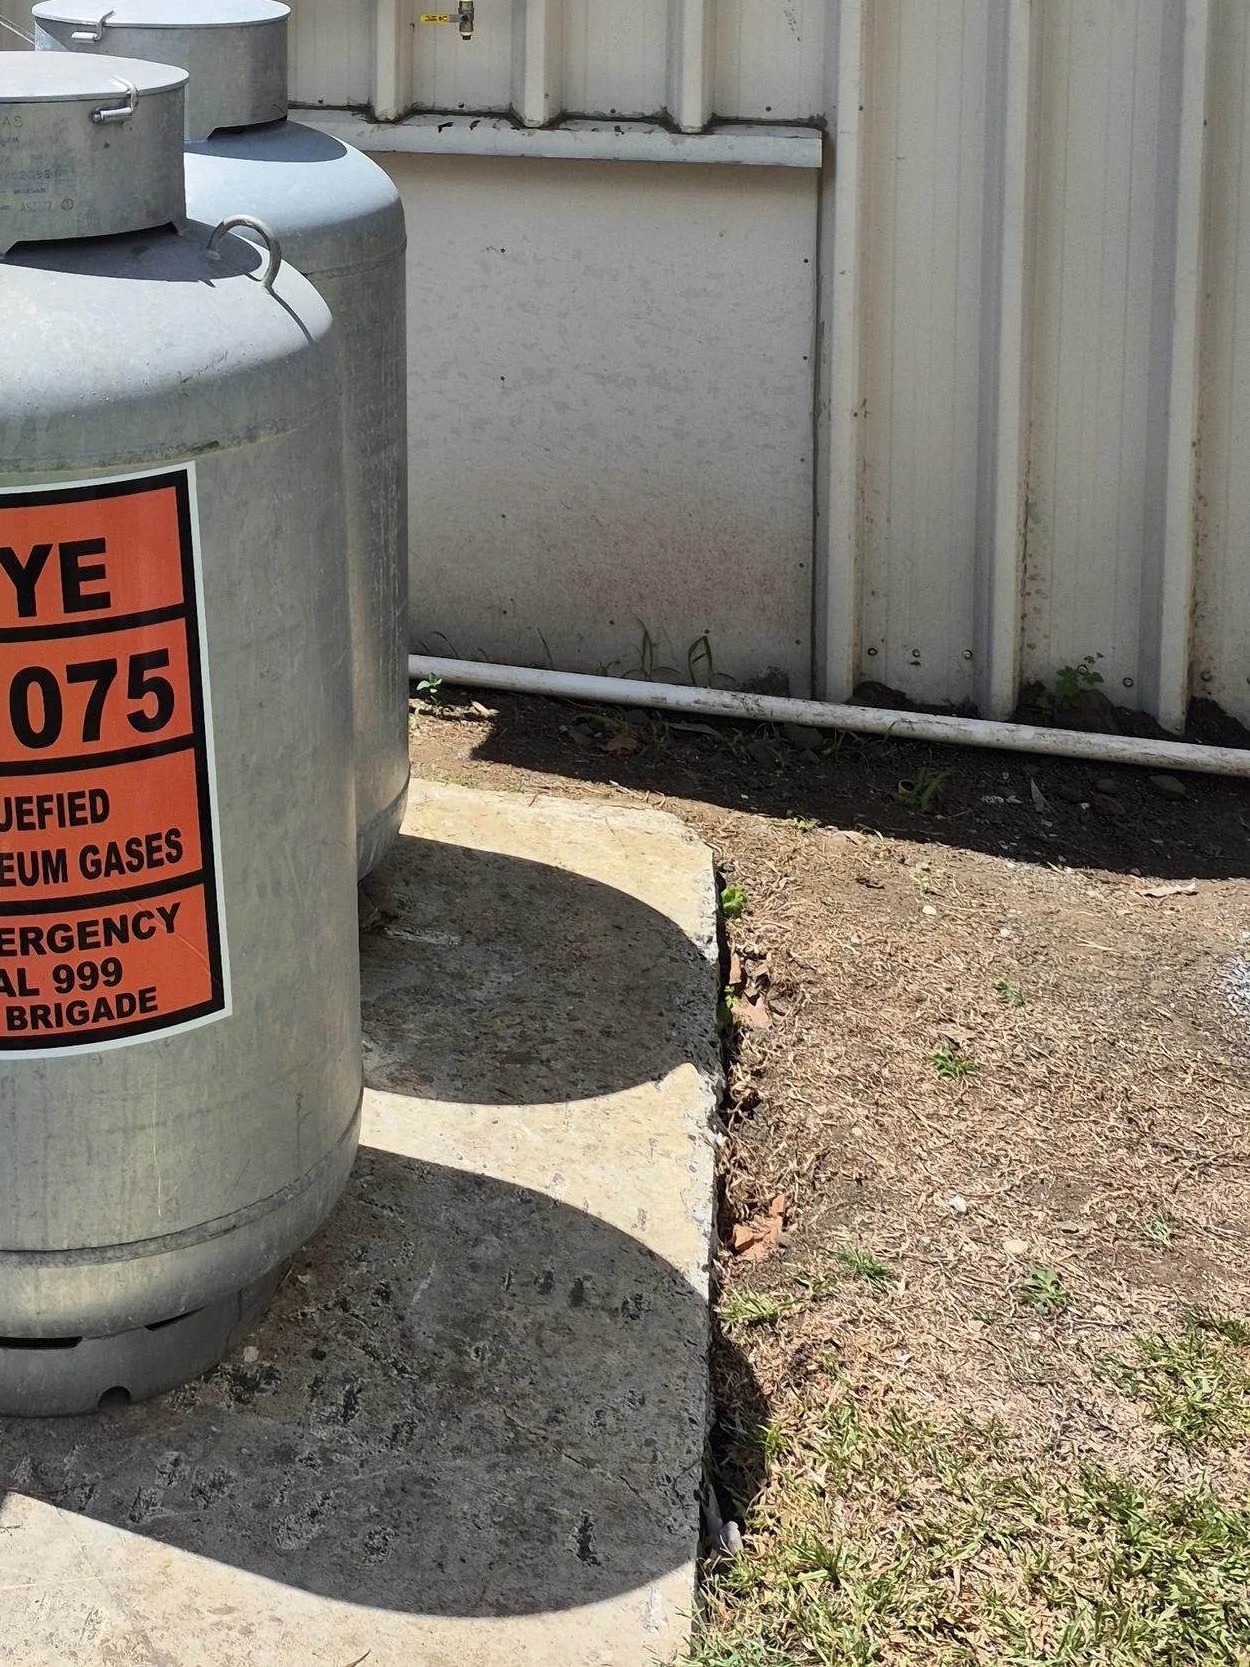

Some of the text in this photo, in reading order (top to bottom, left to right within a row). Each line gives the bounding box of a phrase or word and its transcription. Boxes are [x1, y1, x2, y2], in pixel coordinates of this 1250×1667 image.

[78, 829, 184, 881] GASES
[52, 957, 124, 993] 999
[6, 986, 158, 1031] BRIGADE
